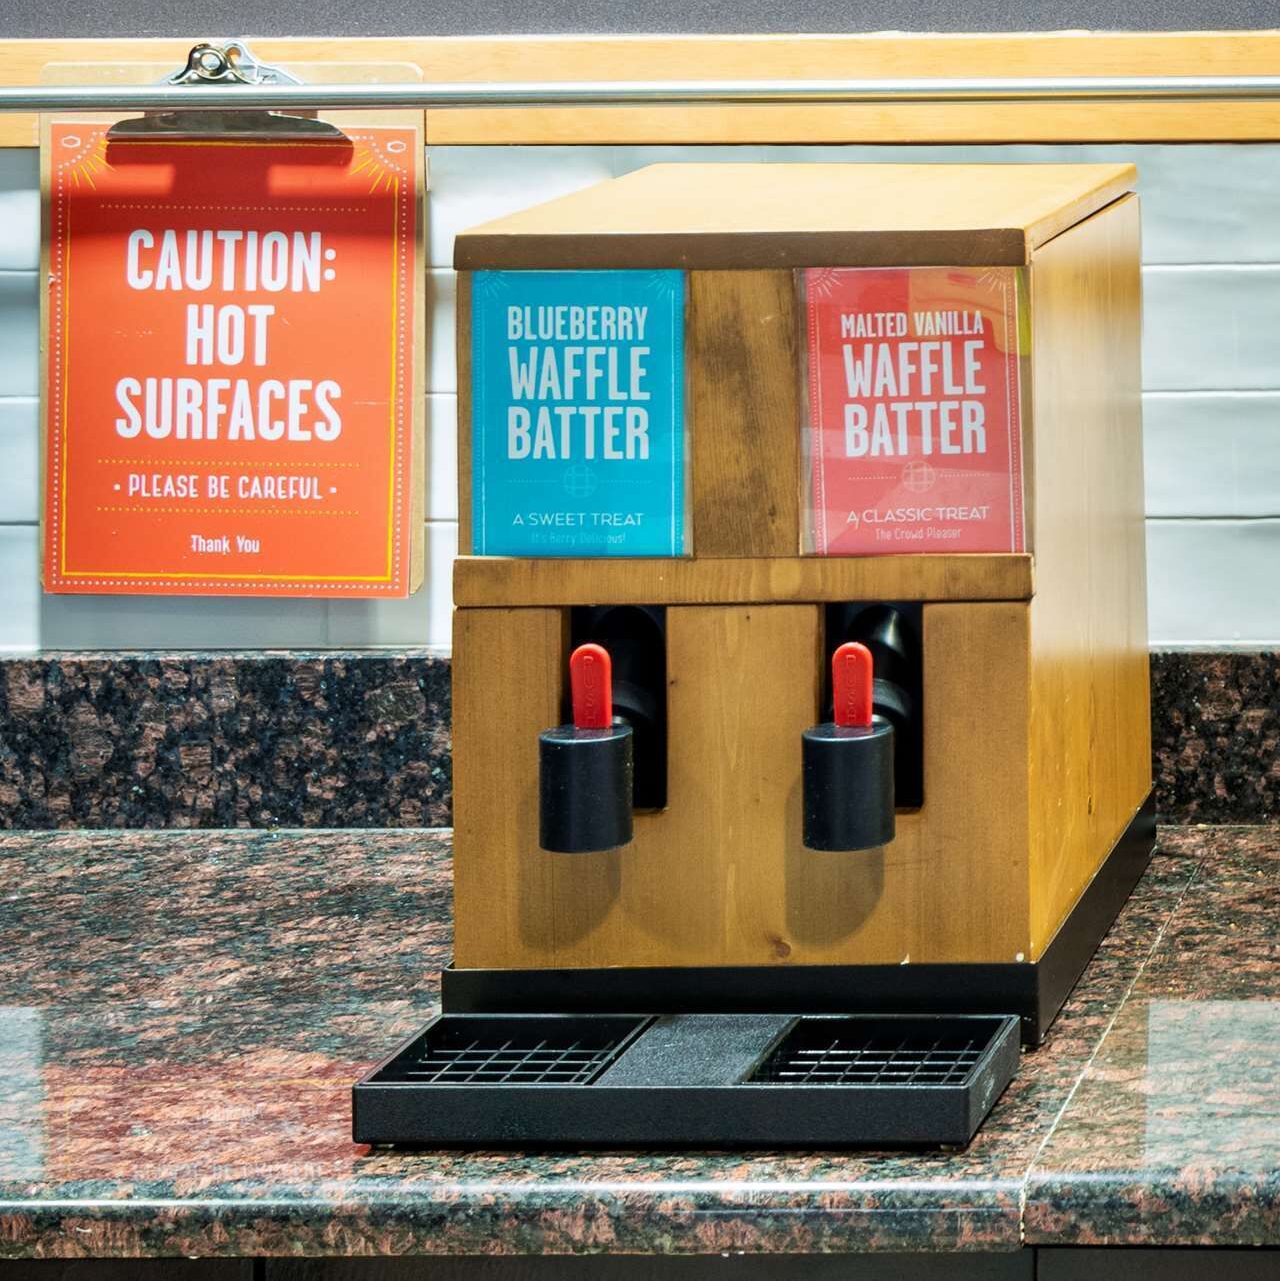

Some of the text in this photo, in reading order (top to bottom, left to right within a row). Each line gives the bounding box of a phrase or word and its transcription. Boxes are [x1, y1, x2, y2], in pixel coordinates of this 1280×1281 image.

[126, 229, 336, 293] CAUTION:
[186, 303, 276, 366] HOT
[507, 305, 648, 341] BLUEBERRY
[841, 310, 983, 339] MALTED VANILLA
[509, 346, 651, 401] WAFFLE
[843, 341, 986, 398] WAFFLE
[115, 377, 342, 442] SURFACES
[843, 400, 987, 458] BATTER
[507, 406, 650, 461] BATTER
[128, 474, 323, 500] PLEASE BE CAREFUL
[512, 512, 645, 527] A SWEET TREAT
[862, 507, 933, 524] CLASSIC
[935, 505, 991, 521] TREAT
[875, 526, 962, 541] The Crowd Pleaser
[190, 534, 260, 555] Thank You
